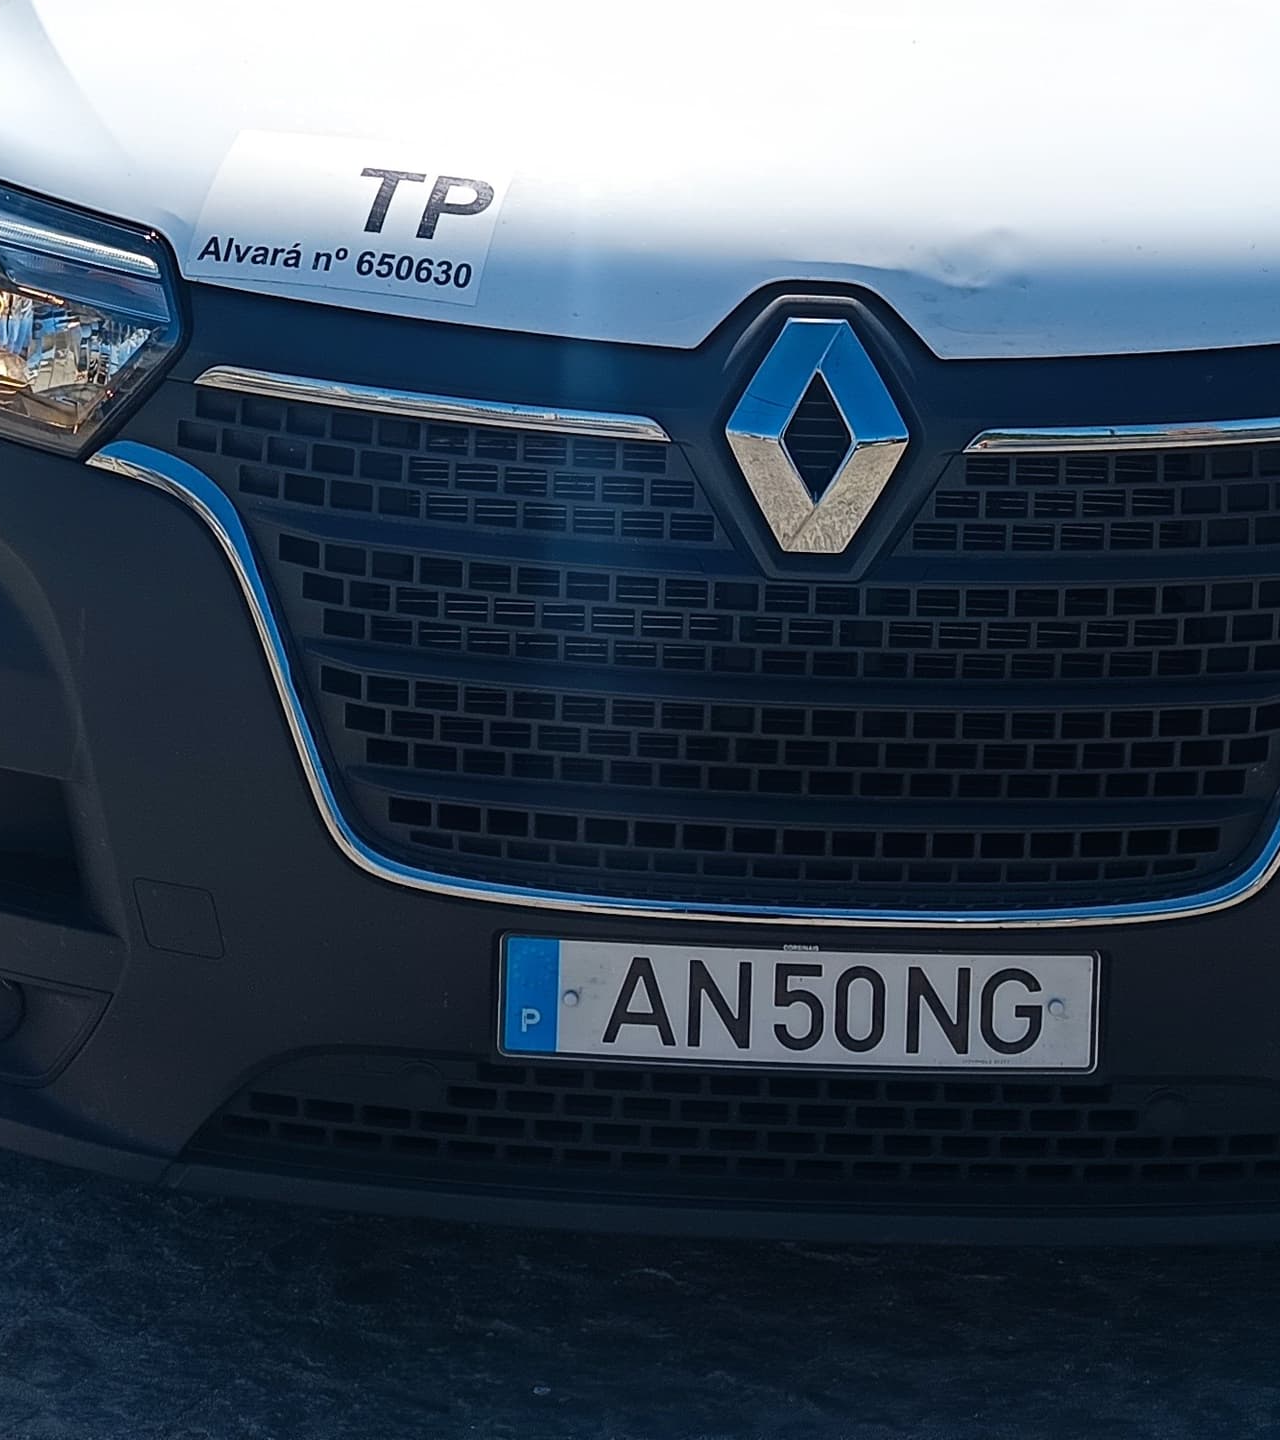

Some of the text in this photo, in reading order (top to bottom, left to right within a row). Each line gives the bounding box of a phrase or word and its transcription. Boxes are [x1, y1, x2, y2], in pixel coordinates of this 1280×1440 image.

[360, 167, 495, 240] TP
[197, 235, 302, 269] Alvará
[355, 250, 472, 289] 650630
[520, 1008, 541, 1033] P
[602, 957, 1043, 1054] AN50NG
